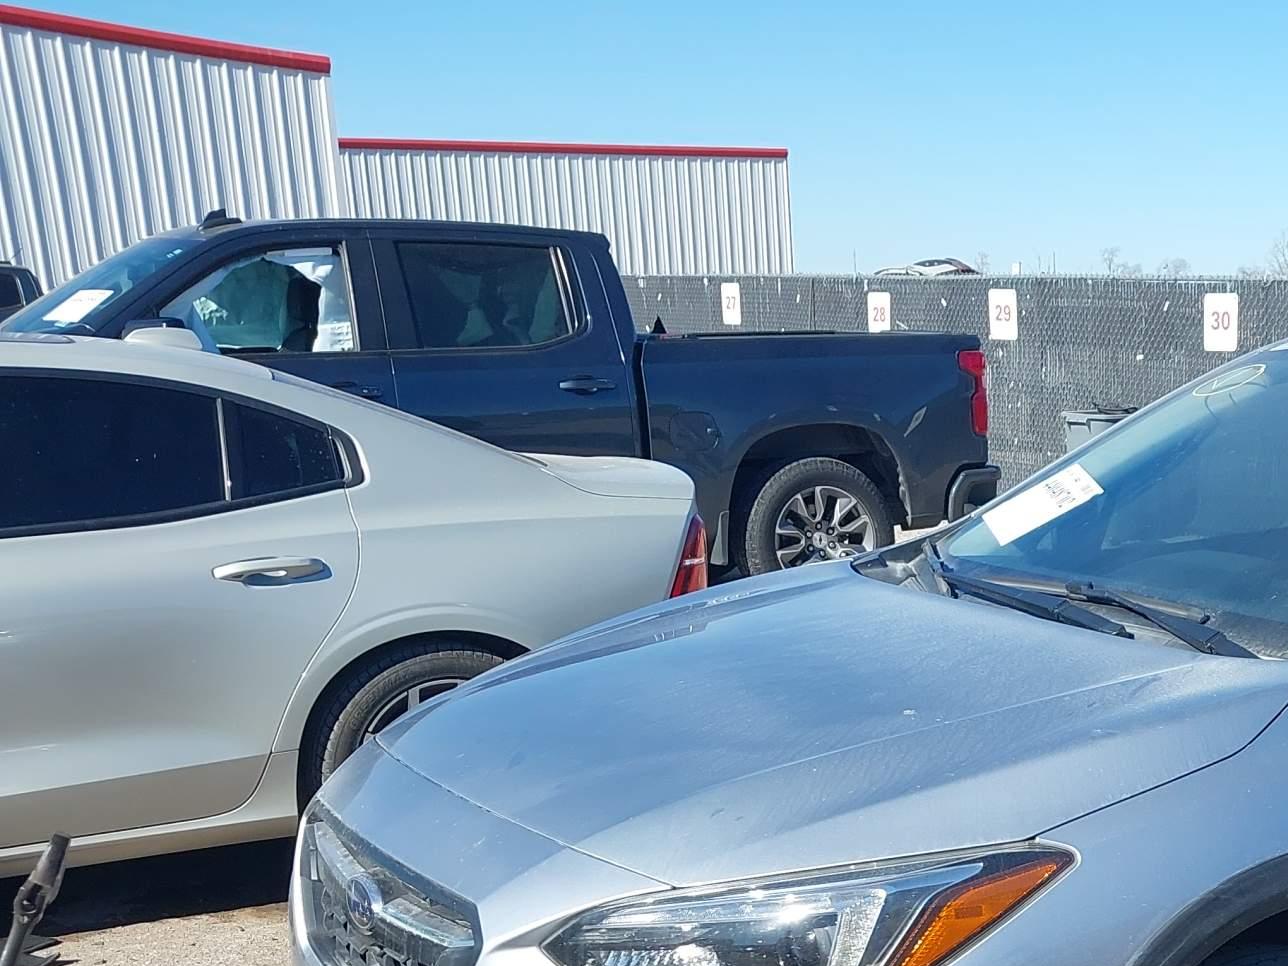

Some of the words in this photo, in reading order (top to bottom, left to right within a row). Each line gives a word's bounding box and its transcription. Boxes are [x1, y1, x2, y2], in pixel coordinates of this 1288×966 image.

[725, 296, 737, 310] 27
[873, 307, 886, 322] 28
[995, 304, 1011, 322] 29
[1211, 311, 1230, 330] 30
